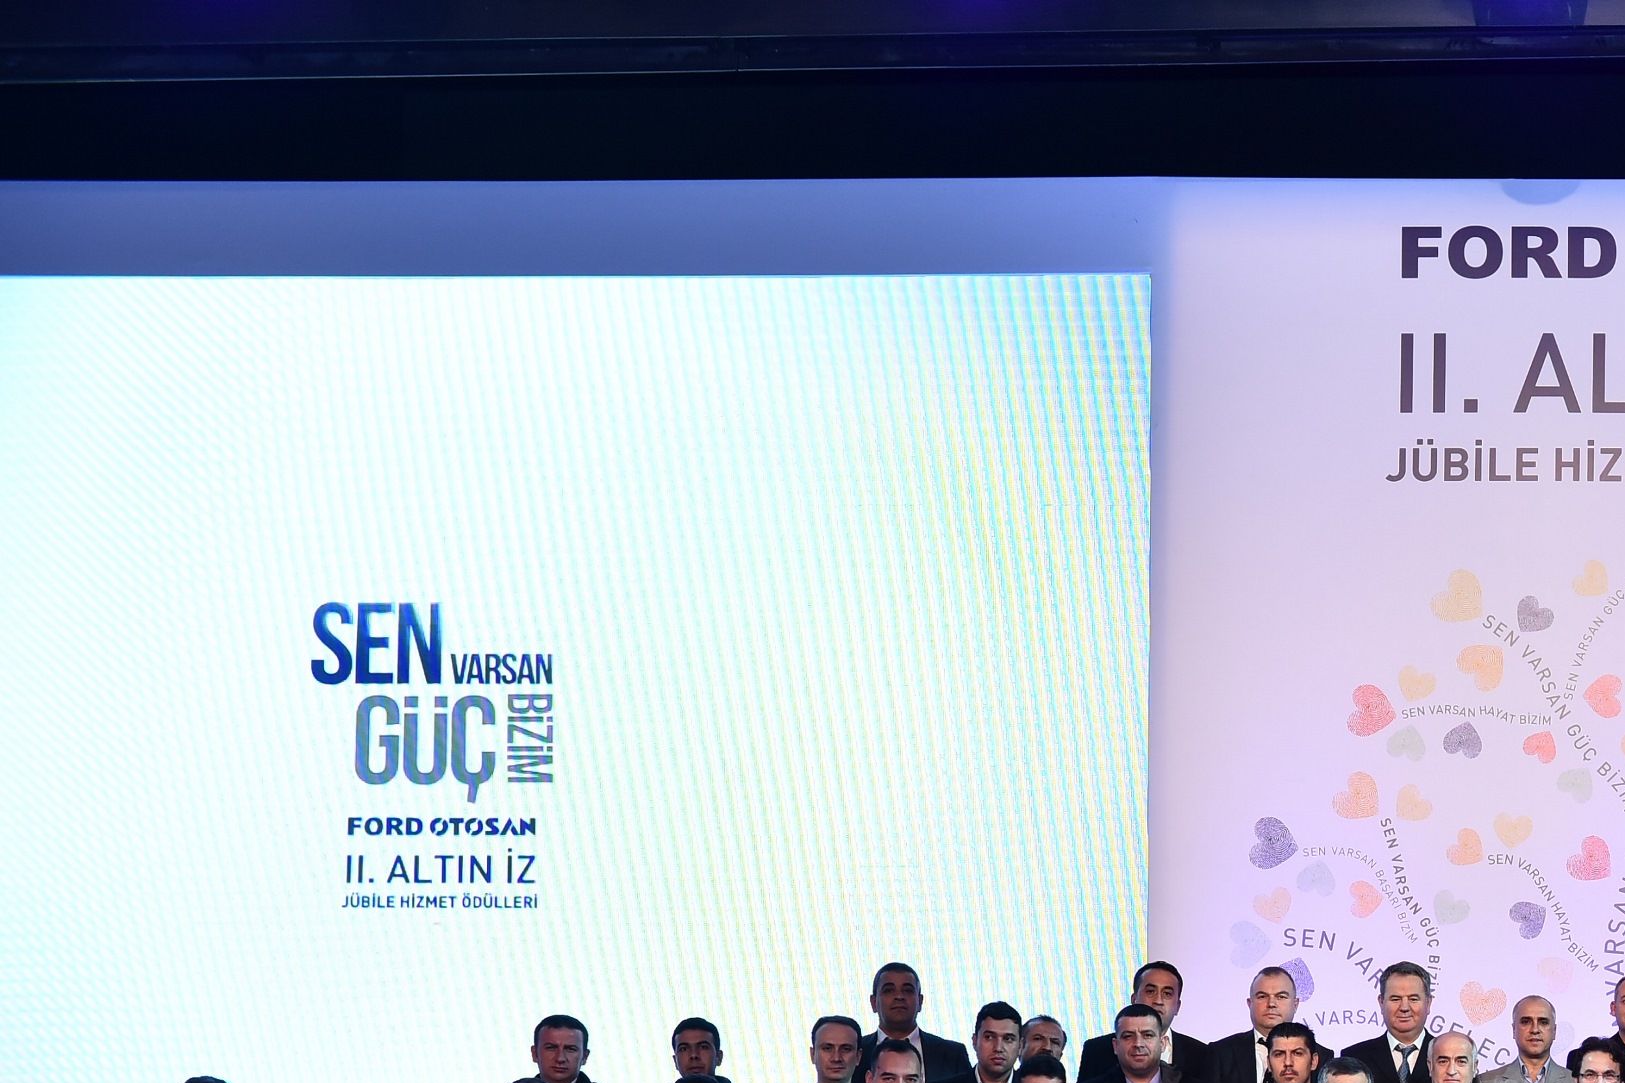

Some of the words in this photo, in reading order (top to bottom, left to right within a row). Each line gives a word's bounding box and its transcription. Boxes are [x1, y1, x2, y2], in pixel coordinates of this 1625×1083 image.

[1402, 226, 1617, 279] FORD
[1400, 333, 1479, 414] II.
[1385, 439, 1540, 484] JÜBİLE
[311, 601, 442, 685] SEN
[450, 653, 554, 685] VARSAN
[1563, 671, 1578, 701] SEN
[1573, 616, 1605, 669] VARSAN
[1401, 706, 1426, 720] SEN
[1428, 702, 1477, 718] VARSAN
[1478, 704, 1517, 725] HAYAT
[1519, 709, 1552, 727] BİZİM
[1482, 614, 1520, 648] SEN
[1521, 644, 1571, 721] VARSAN
[1567, 722, 1599, 763] GÜÇ
[355, 695, 496, 804] GÜÇ
[507, 693, 554, 783] BİZİM
[346, 855, 375, 884] II.
[387, 855, 493, 884] ALTIN
[507, 848, 536, 884] İZ
[347, 817, 423, 836] FORD
[430, 817, 536, 836] OTOSAN
[341, 892, 395, 909] JÜBİLE
[400, 892, 457, 909] HİZMET
[462, 892, 538, 909] ÖDÜLLERİ
[1302, 846, 1326, 858] SEN
[1331, 846, 1377, 869] VARSAN
[1397, 912, 1419, 944] BİZİM
[1380, 817, 1399, 849] SEN
[1391, 853, 1423, 916] VARSAN
[1420, 917, 1441, 948] GÜÇ
[1487, 854, 1514, 865] SEN
[1517, 857, 1556, 902] VARSAN
[1551, 901, 1572, 942] HAYAT
[1567, 942, 1600, 972] BİZİM
[1283, 928, 1337, 952] SEN
